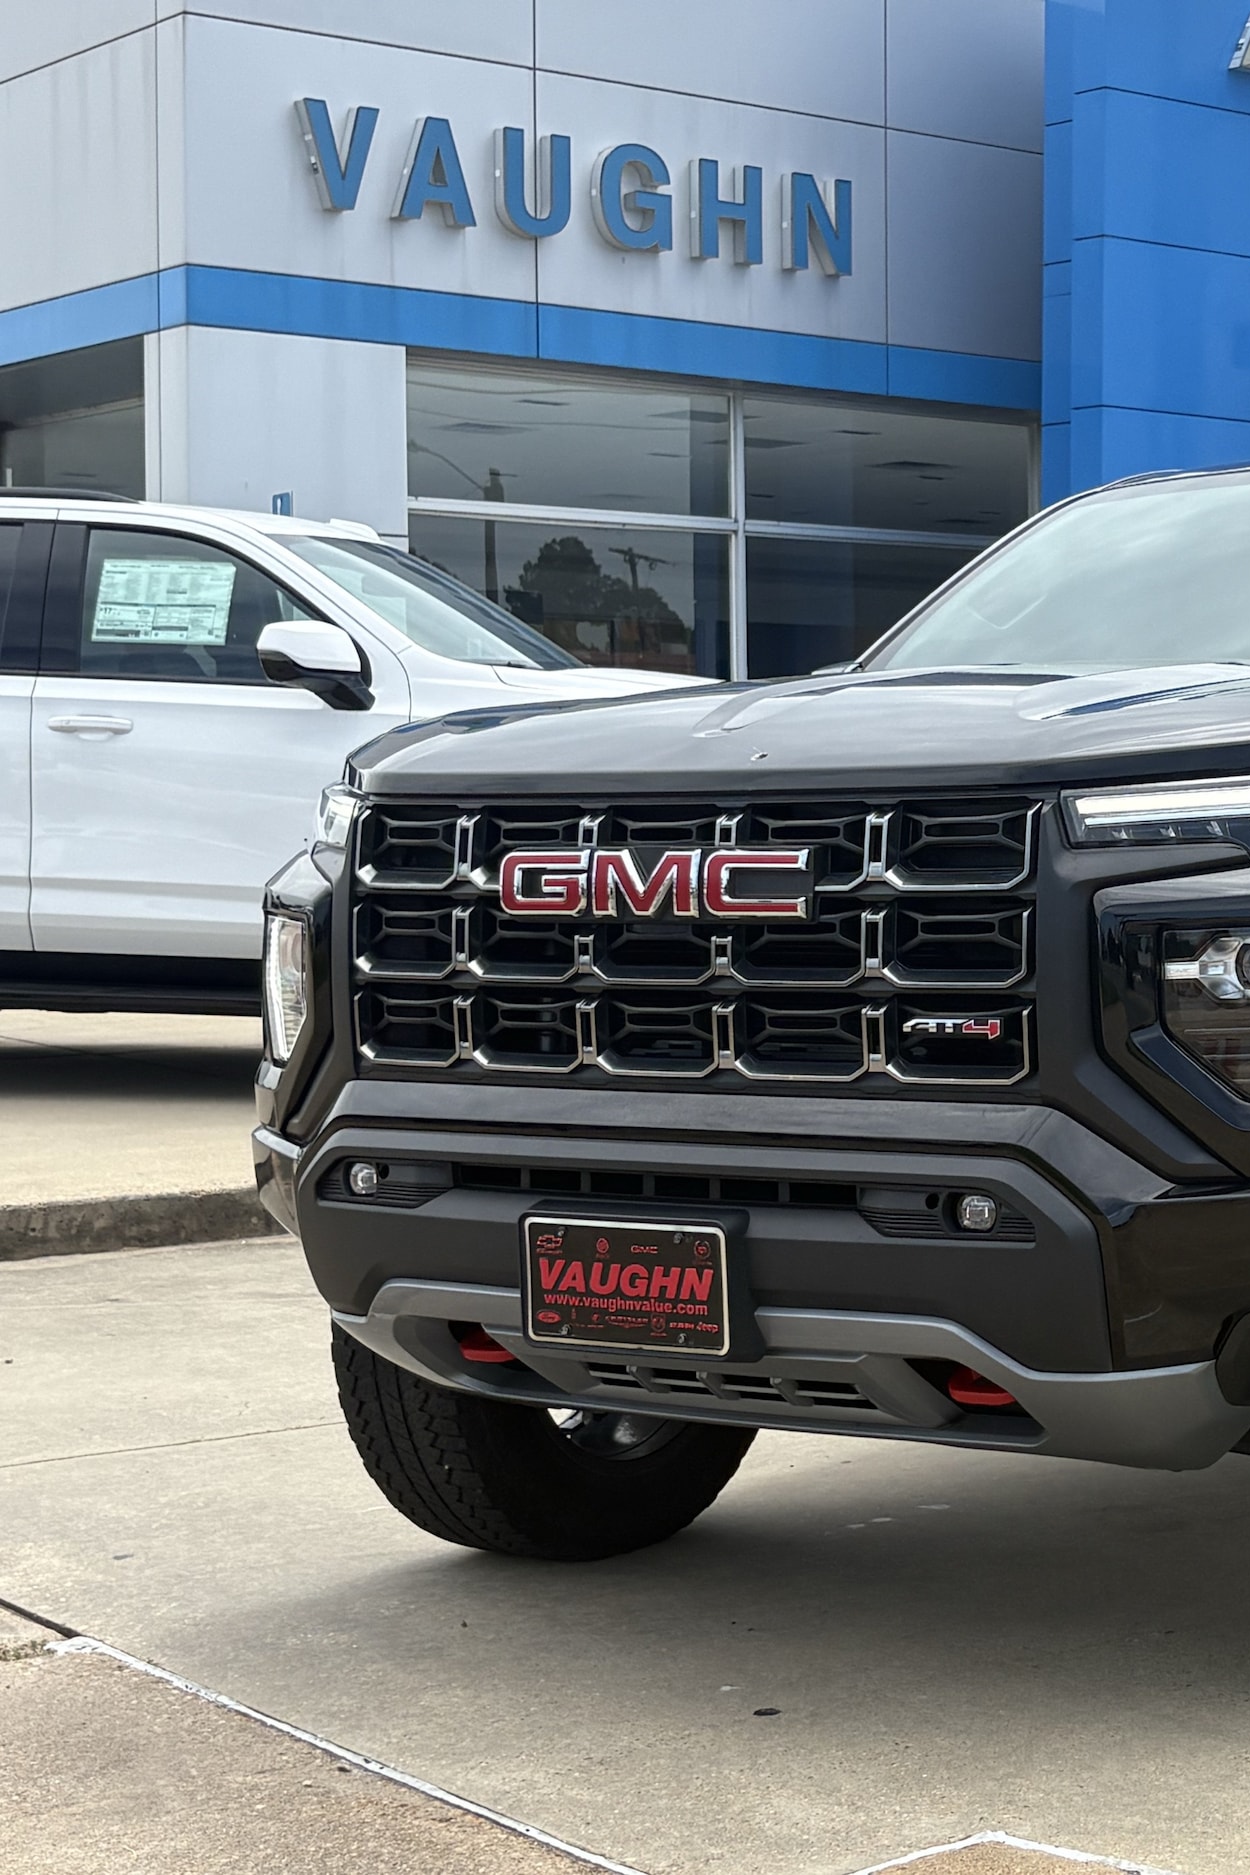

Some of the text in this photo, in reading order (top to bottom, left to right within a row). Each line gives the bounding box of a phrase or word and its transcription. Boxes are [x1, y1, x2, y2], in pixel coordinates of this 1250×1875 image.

[296, 97, 853, 277] VAUGHN
[499, 848, 811, 918] GMC
[902, 1018, 1001, 1040] AT4
[539, 1257, 714, 1302] VAUGHN
[544, 1293, 708, 1317] www.vaughnvalue.com
